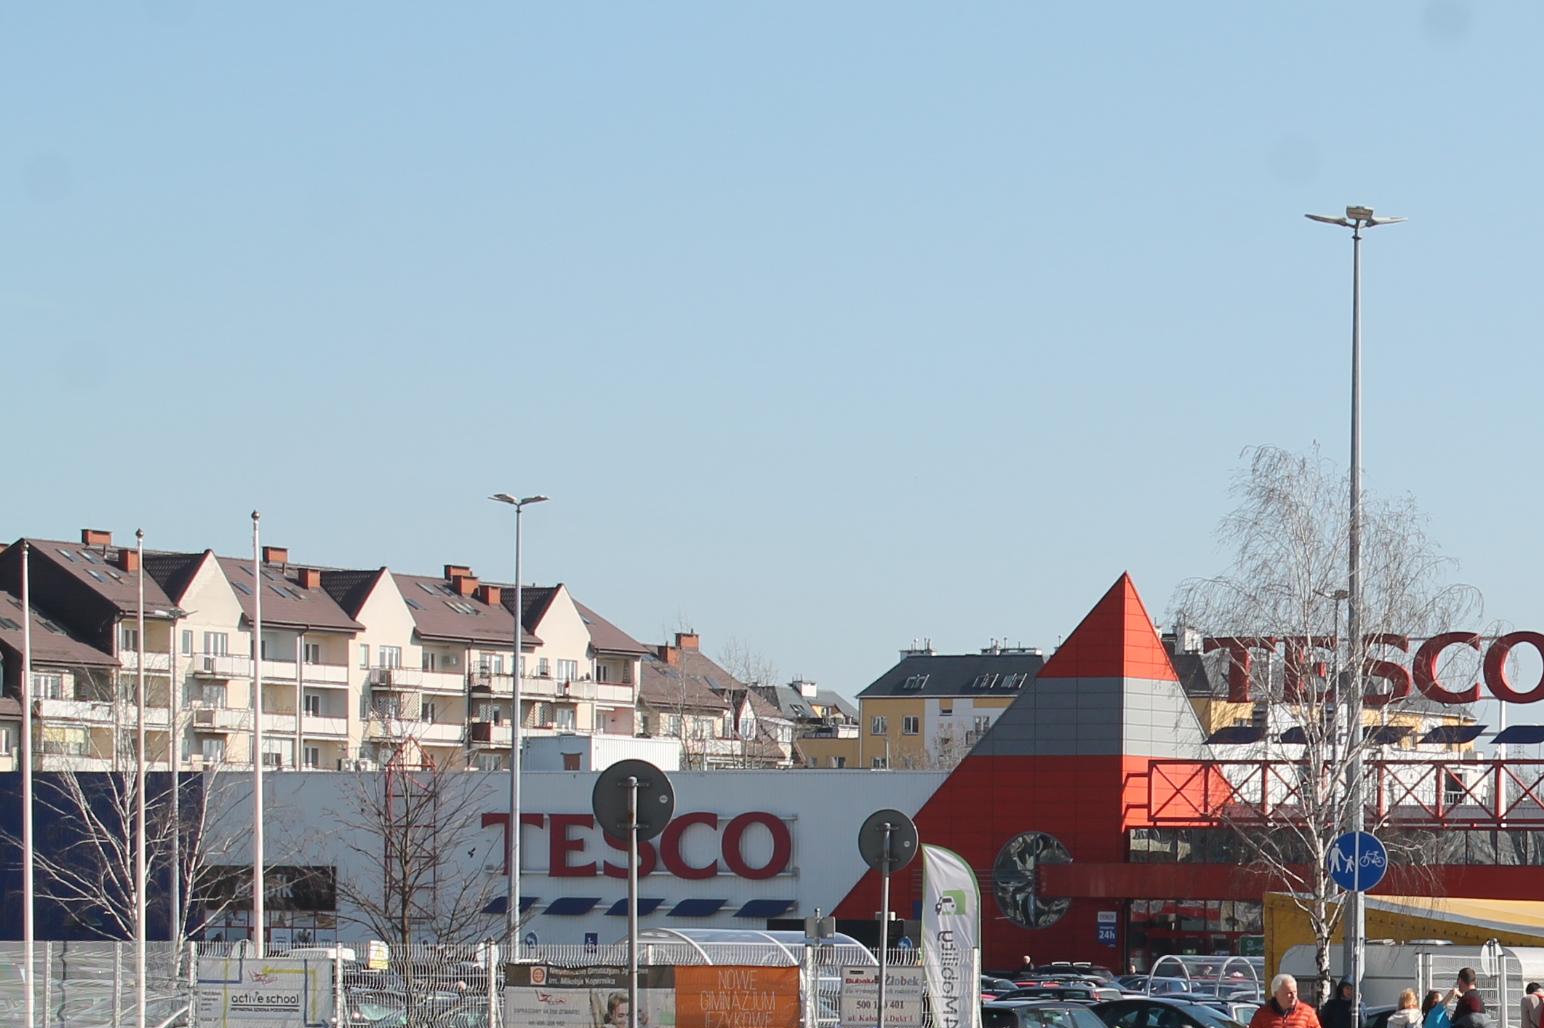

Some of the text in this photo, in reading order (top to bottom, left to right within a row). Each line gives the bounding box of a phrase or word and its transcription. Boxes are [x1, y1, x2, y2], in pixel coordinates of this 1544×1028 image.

[481, 811, 792, 880] TESCO
[1099, 930, 1116, 939] 24h
[718, 968, 758, 991] NOWE
[231, 991, 264, 1004] active
[266, 993, 299, 1004] school
[700, 990, 776, 1011] GIMNAZJUM
[856, 1000, 871, 1010] 500
[889, 1000, 904, 1010] 401
